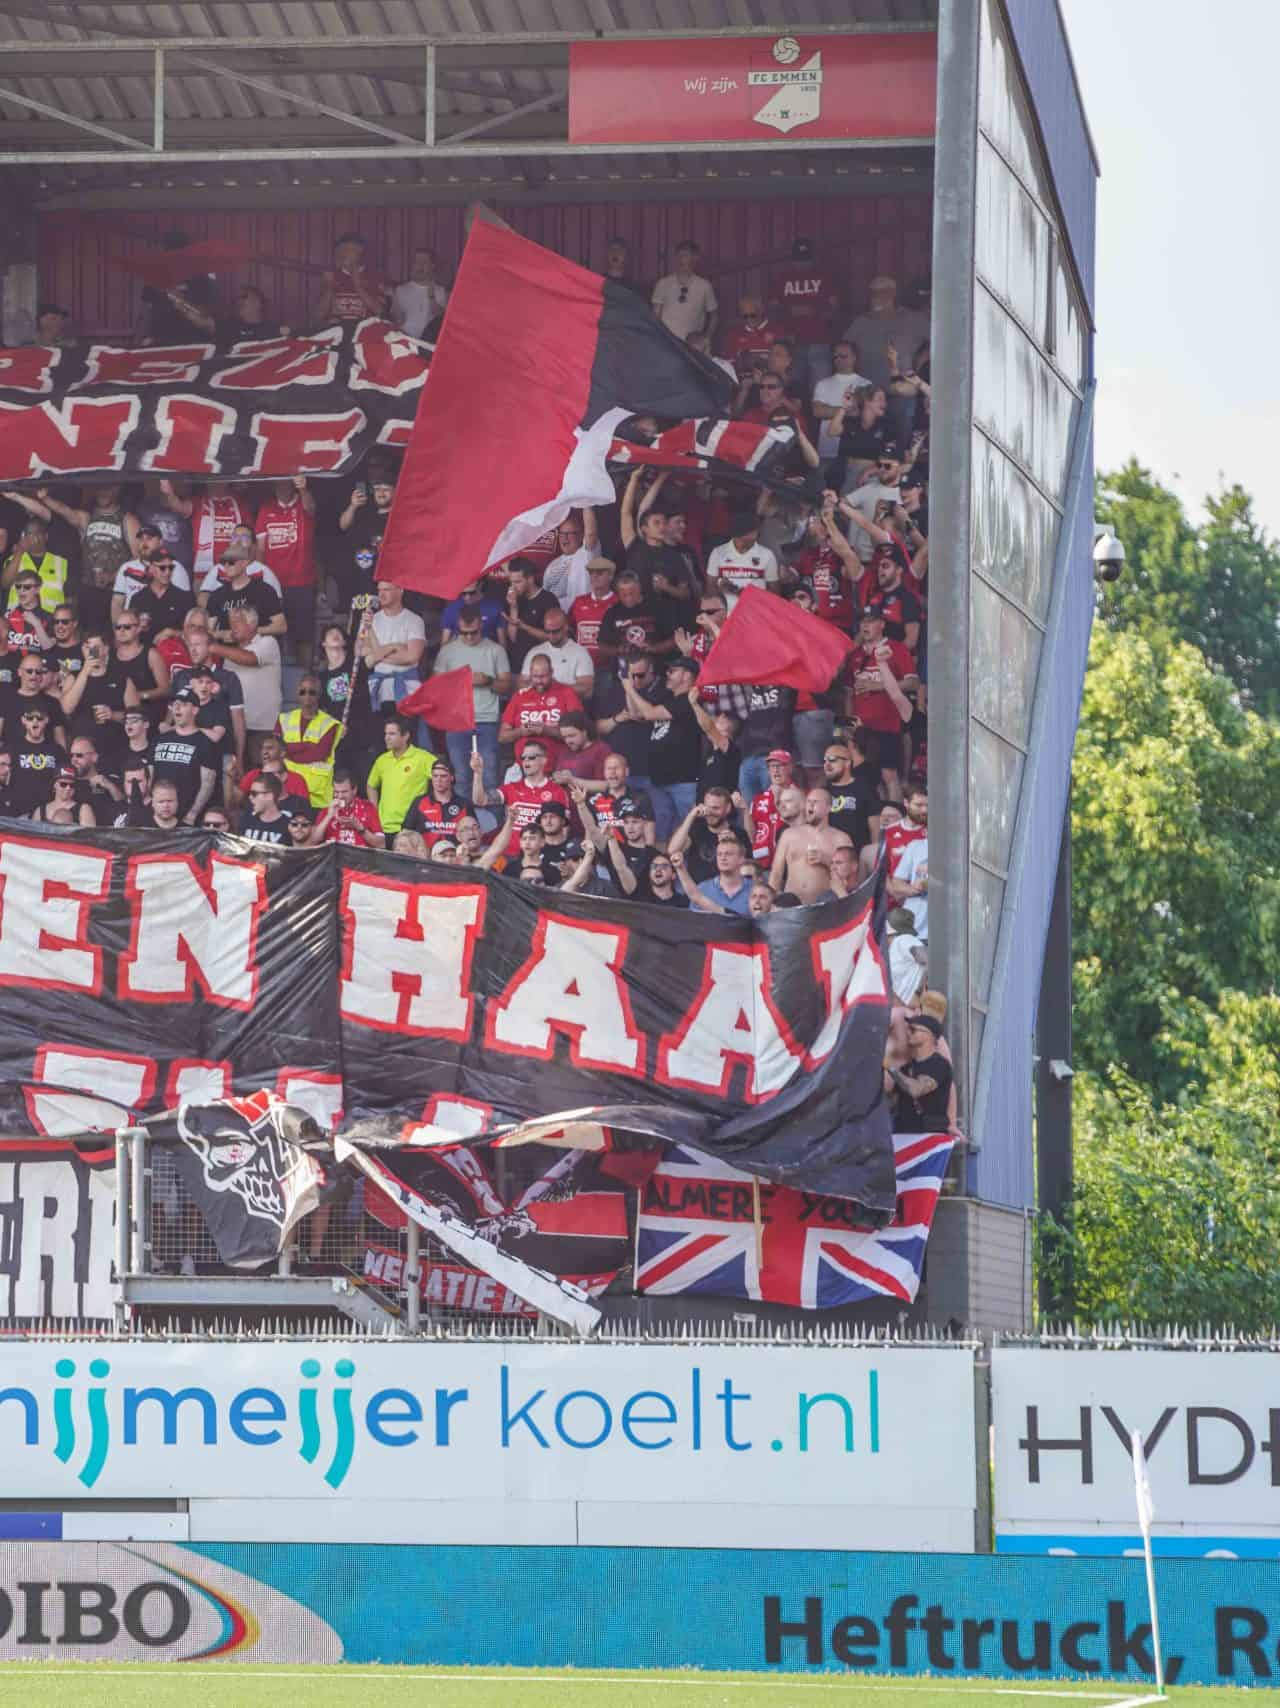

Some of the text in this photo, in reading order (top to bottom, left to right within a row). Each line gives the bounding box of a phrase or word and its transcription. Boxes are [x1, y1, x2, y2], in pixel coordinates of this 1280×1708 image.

[771, 71, 818, 82] EMMEN
[784, 279, 822, 297] ALLY
[520, 707, 561, 724] sens
[762, 1595, 1280, 1684] Heftruck, R
